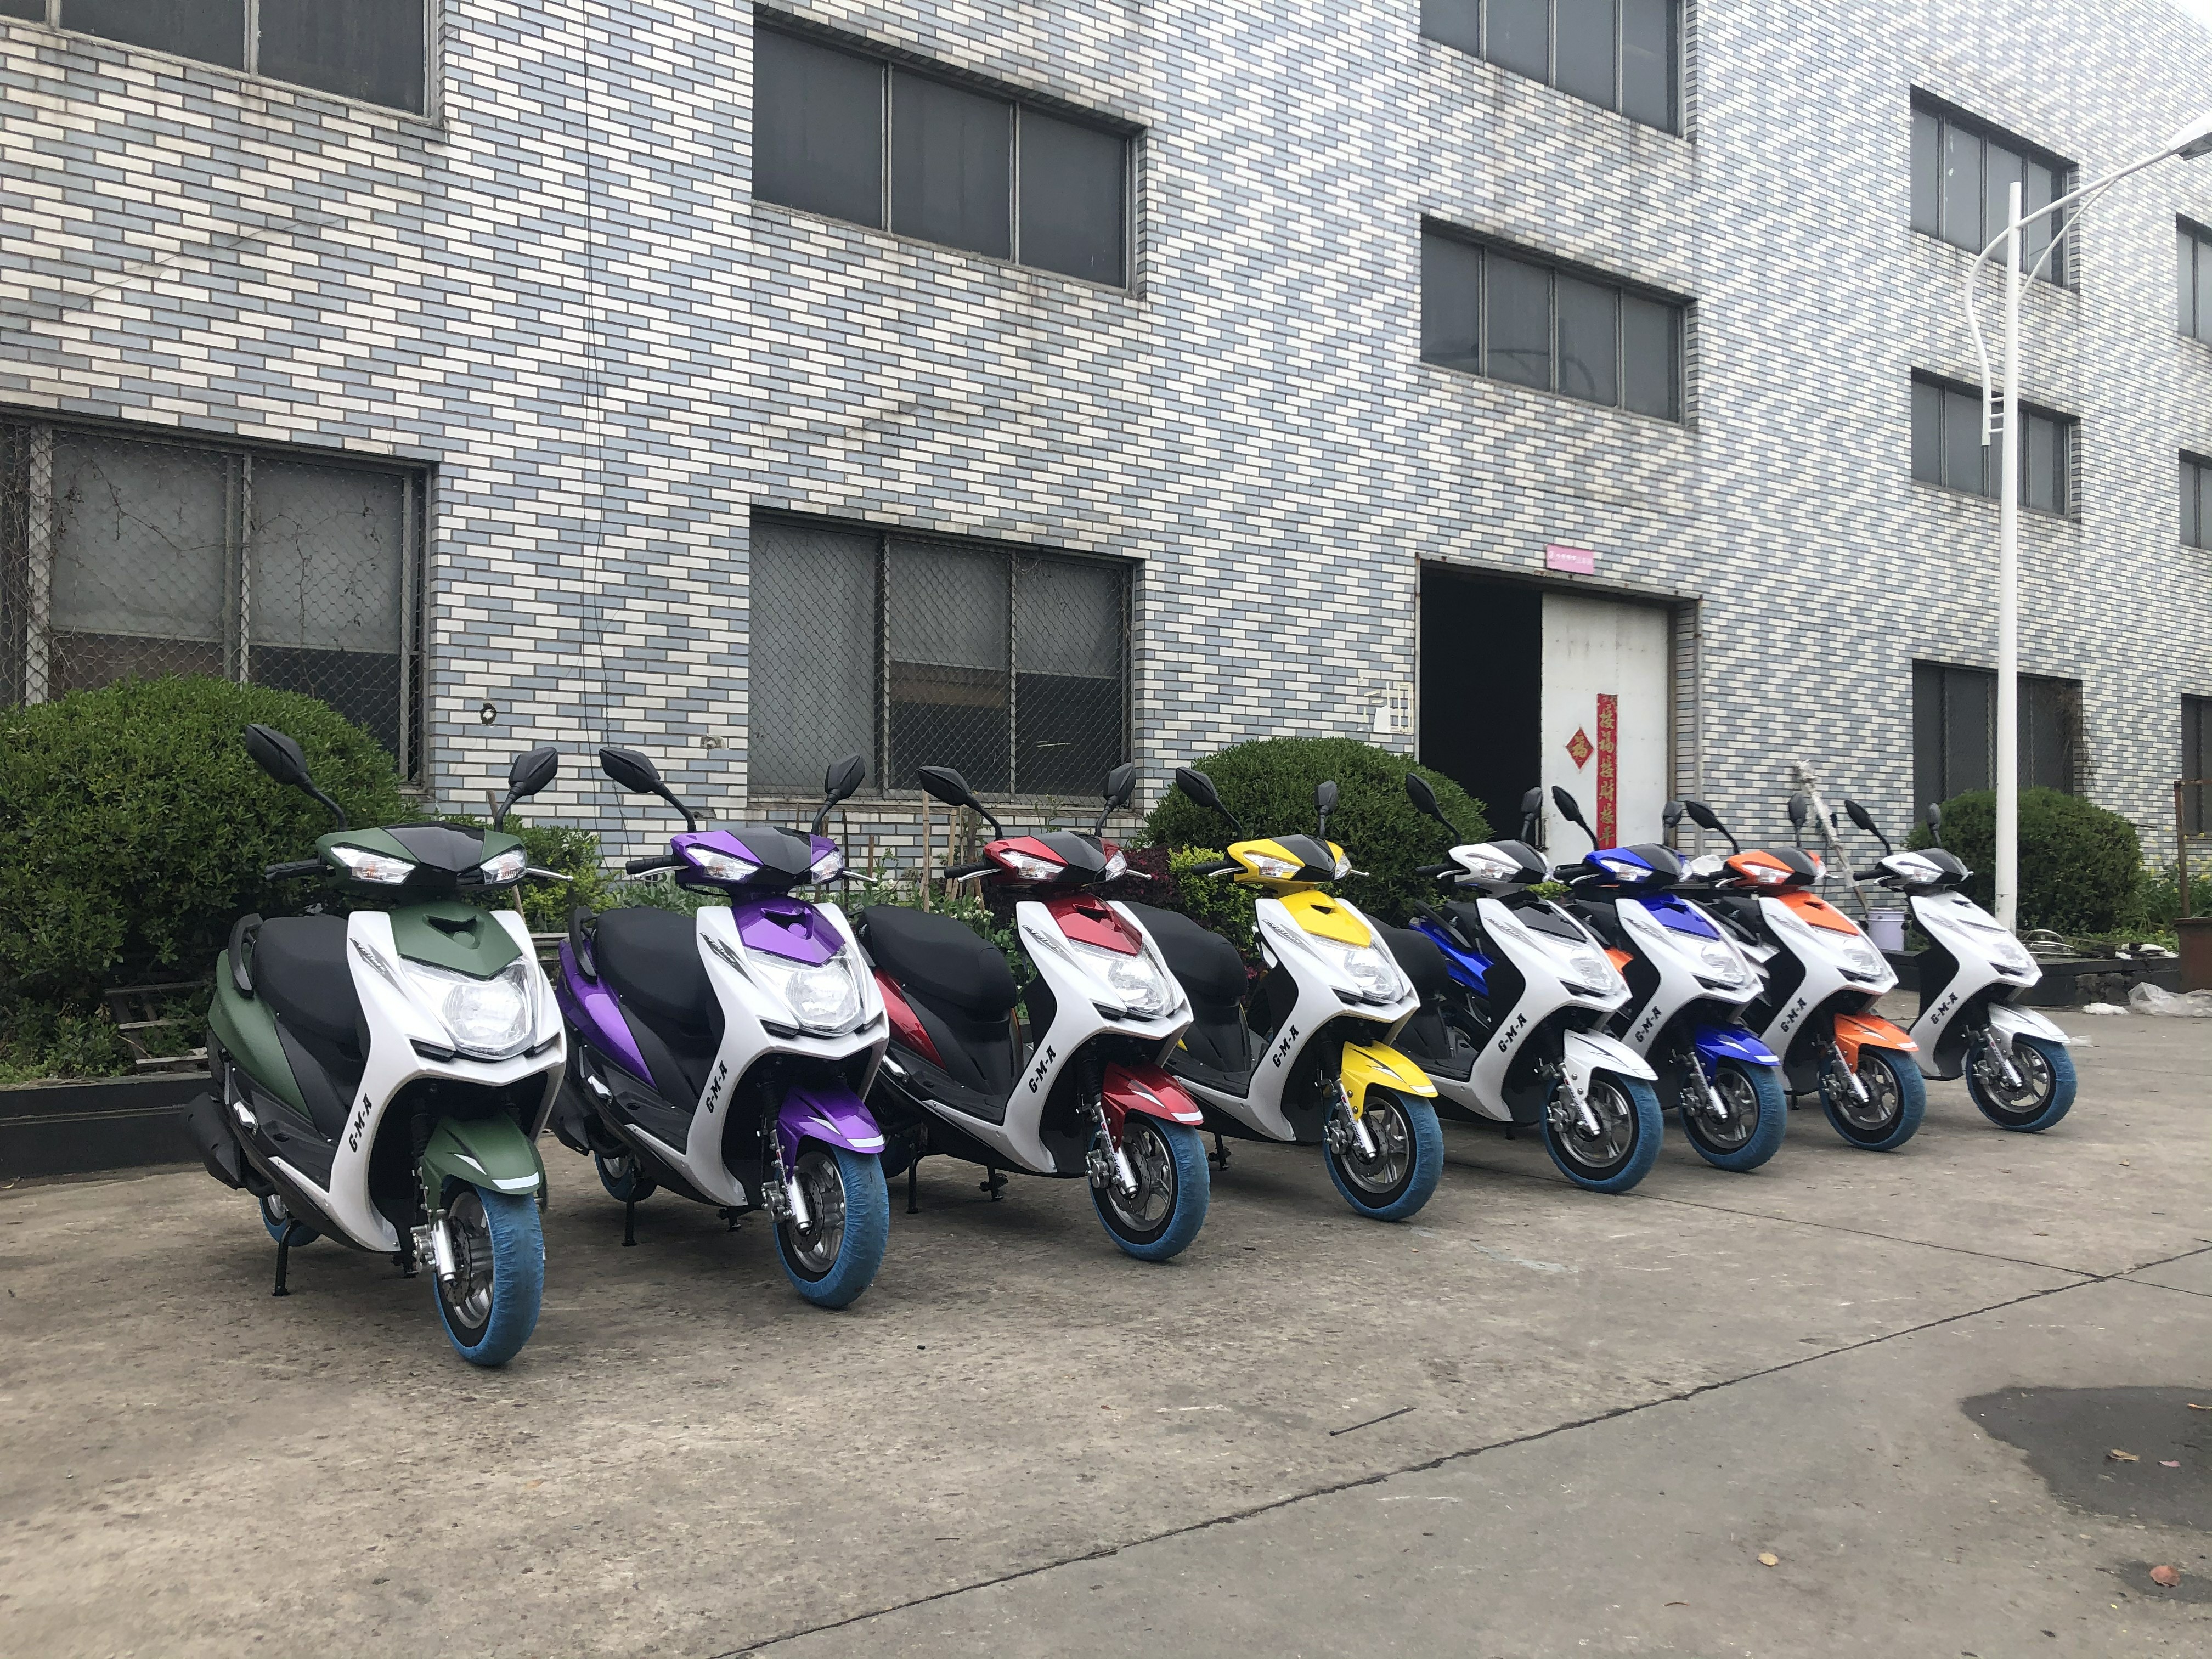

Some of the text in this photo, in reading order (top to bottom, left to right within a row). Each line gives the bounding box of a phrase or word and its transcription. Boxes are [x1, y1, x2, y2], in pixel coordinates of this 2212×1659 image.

[1635, 1006, 1662, 1042] G-M-A
[1780, 997, 1807, 1032] G-M-A
[1931, 992, 1958, 1024] G-M-A
[1273, 1024, 1299, 1068] G-M-A
[1498, 1013, 1527, 1052] G-M-A
[706, 1060, 727, 1113] G-M-A
[1029, 1045, 1056, 1093] G-M-A
[349, 1092, 372, 1153] G-M-A
